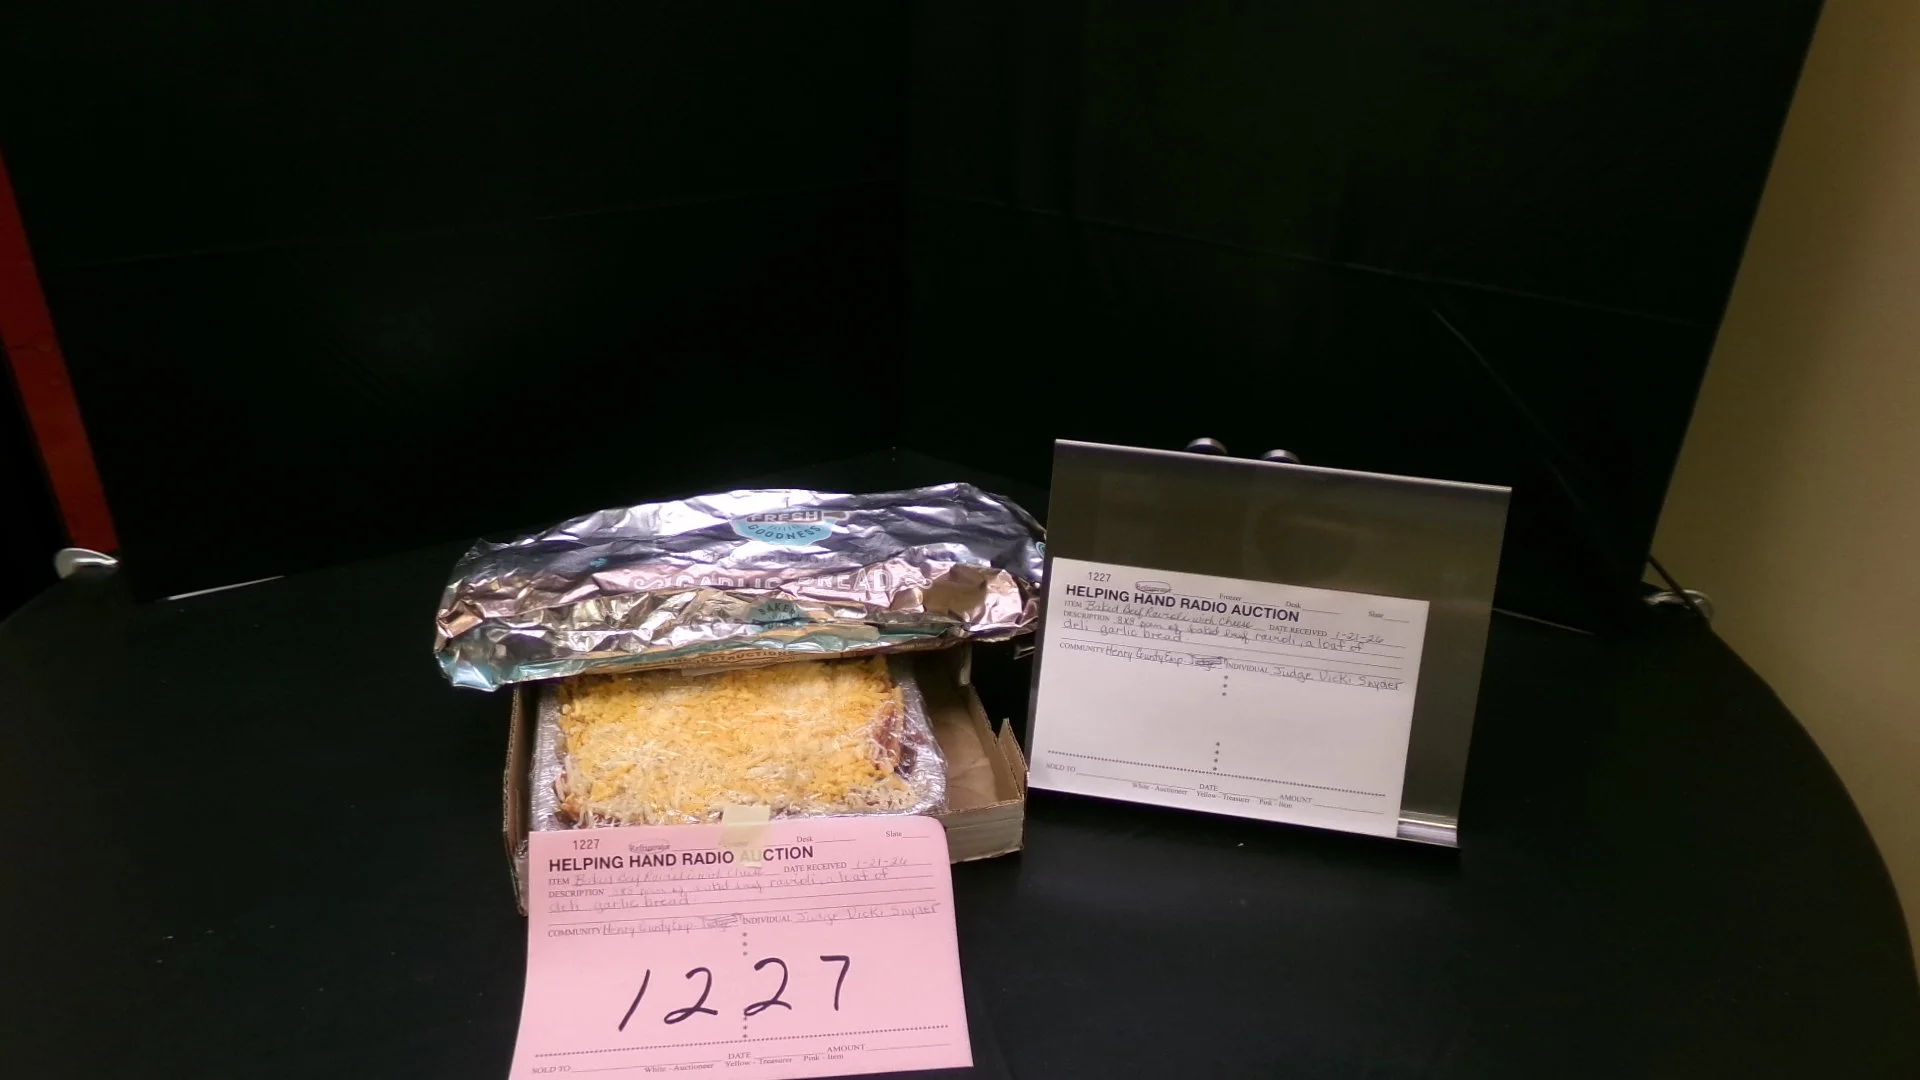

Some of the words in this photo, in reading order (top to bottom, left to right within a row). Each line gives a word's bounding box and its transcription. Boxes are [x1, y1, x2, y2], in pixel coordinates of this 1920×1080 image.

[750, 511, 818, 522] FRESH
[748, 524, 821, 540] GOODNESS
[1087, 571, 1112, 583] 1227
[1064, 600, 1082, 608] ITEM
[1066, 584, 1130, 602] HELPING
[1134, 592, 1176, 607] HAND
[1180, 598, 1227, 613] RADIO
[1231, 604, 1300, 623] AUCTION
[1285, 600, 1301, 609] Desk
[1063, 610, 1110, 621] DESCRIPTION
[1101, 624, 1137, 637] garlic
[1143, 625, 1182, 642] bread
[1269, 624, 1288, 633] DATE
[1290, 627, 1328, 637] RECEIVED
[1059, 641, 1105, 653] COMMUNITY
[1318, 639, 1347, 651] loaf
[1351, 642, 1363, 652] of
[1105, 645, 1133, 661] Henry
[1225, 661, 1269, 674] INDIVIDUAL
[1273, 666, 1313, 683] Judge
[1046, 762, 1065, 771] SOLD
[1066, 765, 1076, 773] TO
[1155, 785, 1188, 795] Auctioneer
[1199, 783, 1218, 792] DATE
[1196, 790, 1216, 799] Yellow
[1279, 793, 1312, 804] AMOUNT
[1259, 798, 1273, 807] Pink
[796, 835, 813, 844] Desk
[885, 830, 902, 838] Slate
[573, 838, 600, 851] 1227
[548, 855, 624, 873] HELPING
[629, 853, 677, 868] HAND
[681, 850, 735, 866] RADIO
[739, 845, 814, 863] AUCTION
[784, 864, 805, 873] DATE
[806, 861, 847, 872] RECEIVED
[548, 877, 570, 886] ITEM
[548, 888, 605, 898] DESCRIPTION
[742, 914, 791, 925] INDIVIDUAL
[548, 926, 600, 938] COMMUNITY
[618, 955, 852, 1032] 1227
[826, 1043, 866, 1053] AMOUNT
[728, 1052, 751, 1060] DATE
[827, 1053, 844, 1061] Item
[674, 1063, 714, 1072] Auctioneer
[725, 1059, 750, 1068] Yellow
[759, 1057, 793, 1065] Treasurer
[532, 1066, 557, 1075] SOLD
[558, 1065, 571, 1073] TO
